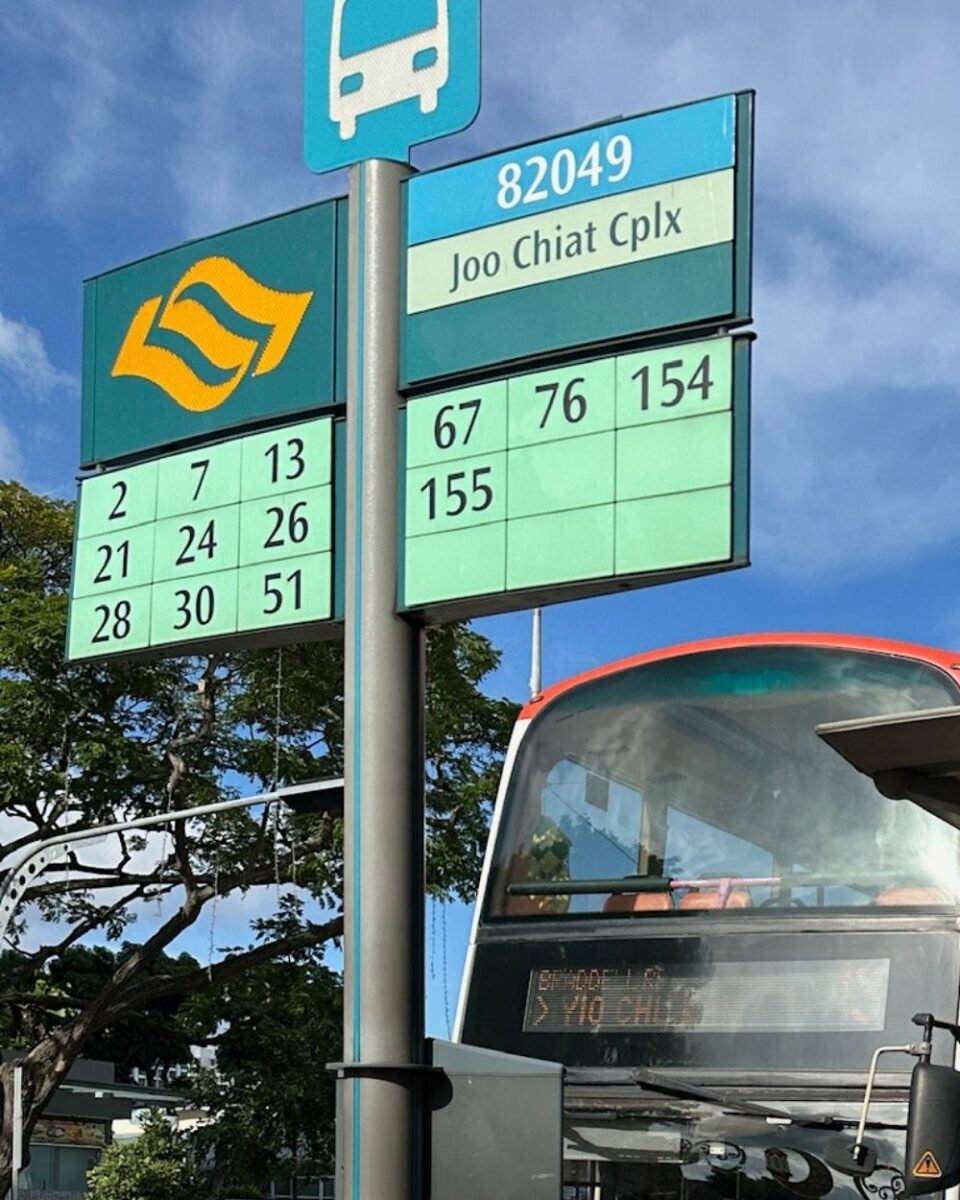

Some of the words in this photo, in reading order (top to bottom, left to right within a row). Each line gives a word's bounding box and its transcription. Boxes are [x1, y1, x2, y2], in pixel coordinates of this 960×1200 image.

[496, 133, 633, 210] 82049
[449, 252, 501, 293] Joo
[513, 222, 597, 271] Chiat
[609, 201, 683, 252] Cplx
[433, 399, 483, 450] 67
[535, 377, 588, 429] 76
[631, 354, 714, 411] 154
[107, 480, 128, 521] 2
[190, 460, 210, 501] 7
[265, 438, 306, 484] 13
[420, 466, 494, 521] 155
[93, 541, 130, 584] 21
[175, 520, 218, 566] 24
[263, 501, 309, 549] 26
[91, 601, 132, 645] 28
[173, 585, 215, 631] 30
[262, 569, 302, 615] 51
